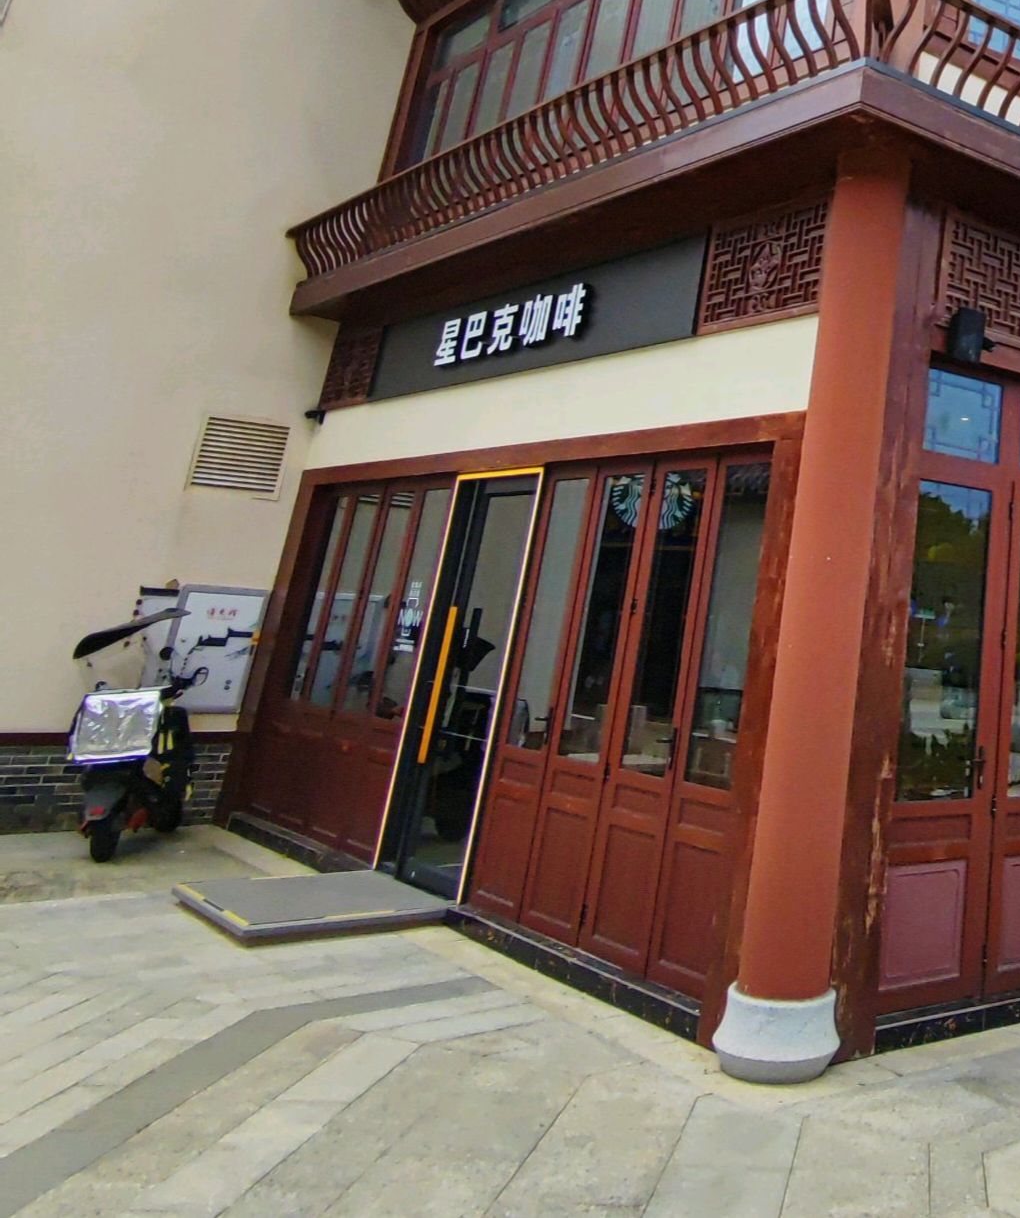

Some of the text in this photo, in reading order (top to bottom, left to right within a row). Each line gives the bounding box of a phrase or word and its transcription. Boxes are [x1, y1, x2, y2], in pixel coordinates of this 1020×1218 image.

[433, 282, 587, 366] 星巴克咖啡
[397, 608, 424, 627] NOW
